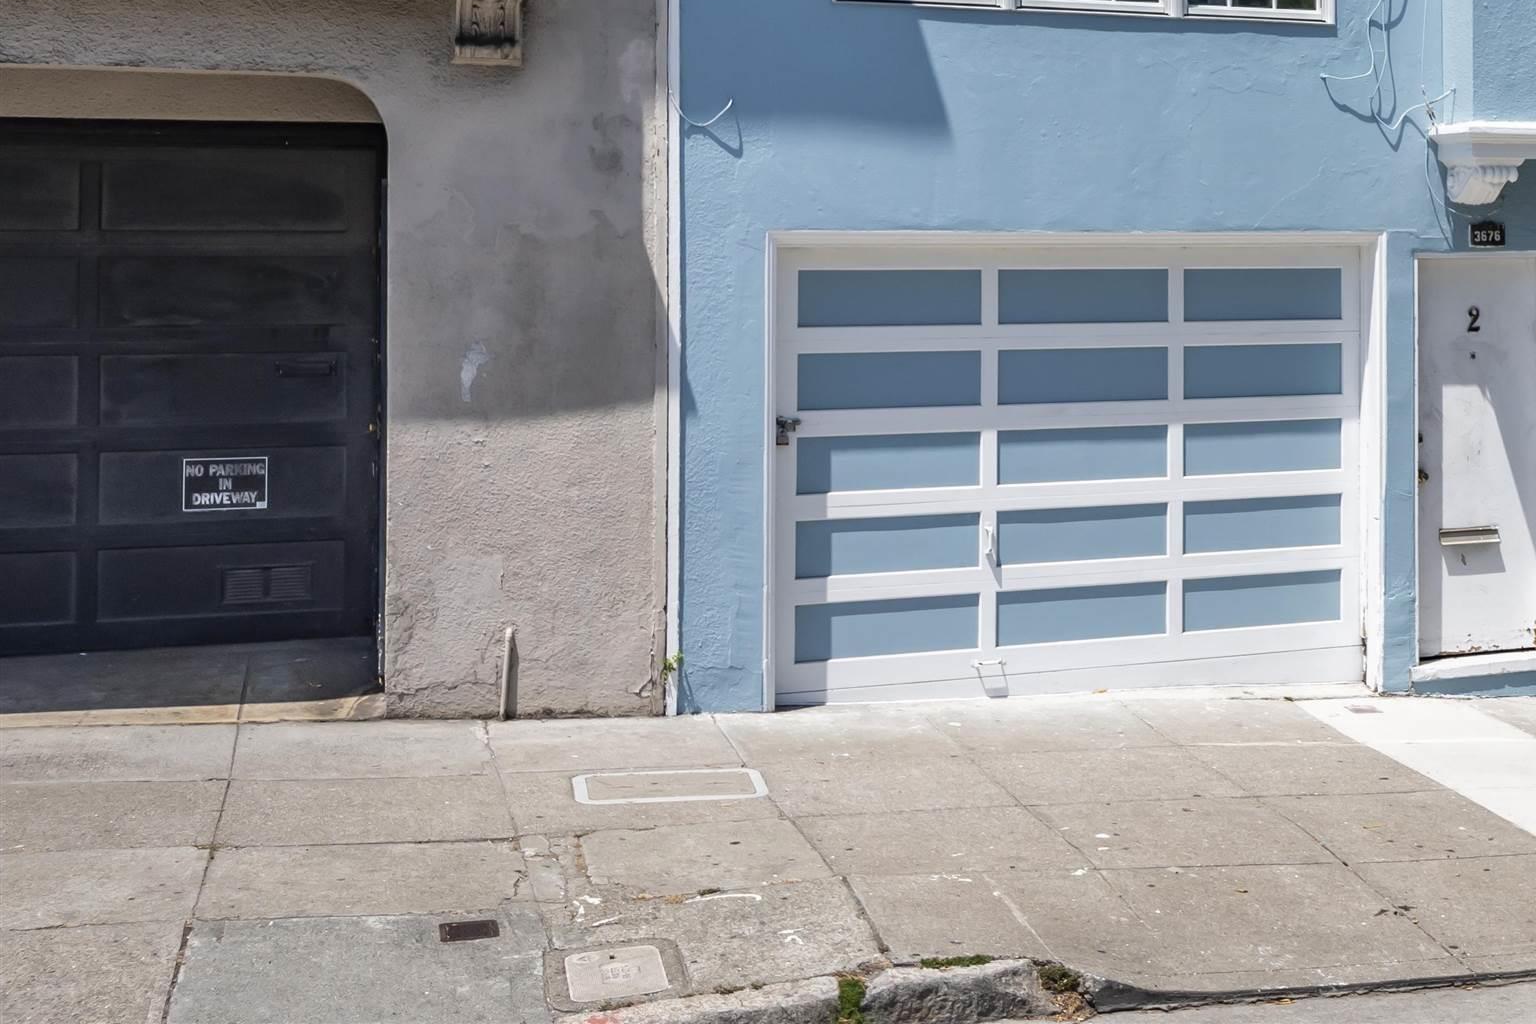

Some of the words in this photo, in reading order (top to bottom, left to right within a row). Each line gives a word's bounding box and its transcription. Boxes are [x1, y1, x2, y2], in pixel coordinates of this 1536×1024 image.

[1474, 230, 1501, 242] 3676
[1467, 305, 1481, 333] 2
[186, 464, 204, 477] NO
[209, 463, 265, 476] PARKING
[218, 478, 232, 490] IN
[192, 491, 258, 505] DRIVEWAY
